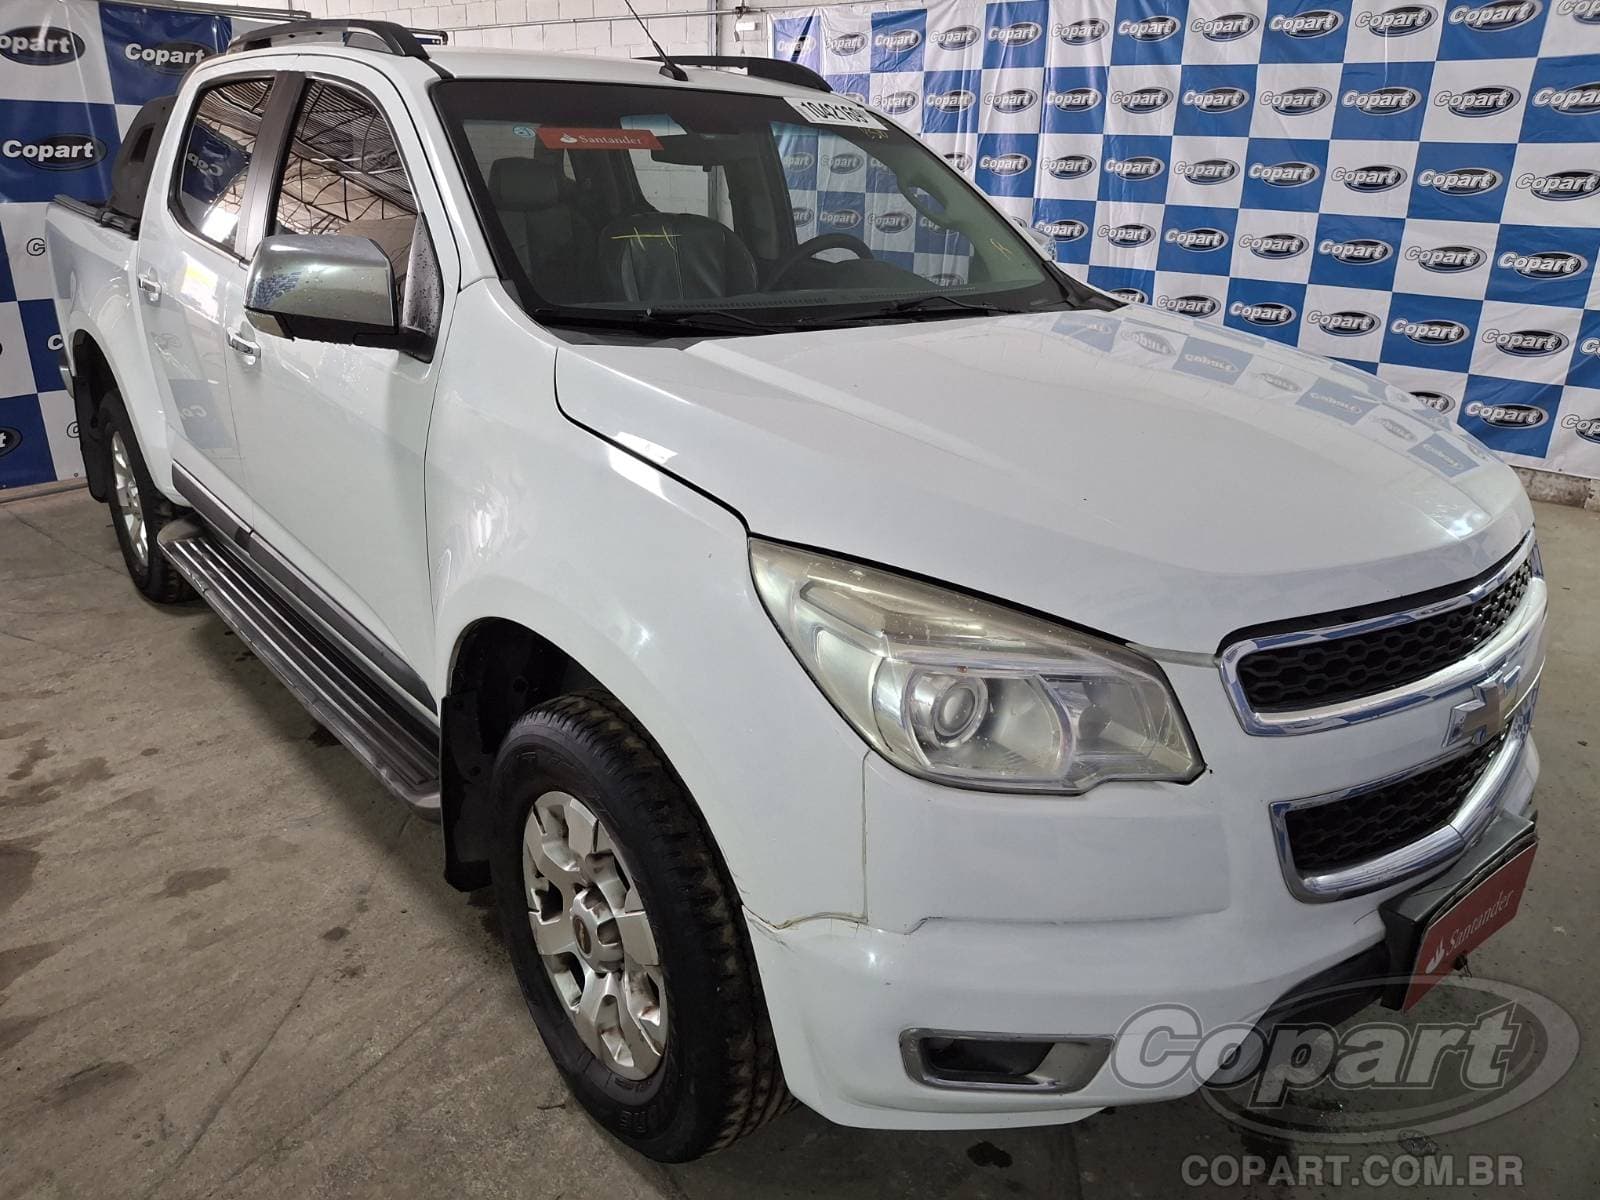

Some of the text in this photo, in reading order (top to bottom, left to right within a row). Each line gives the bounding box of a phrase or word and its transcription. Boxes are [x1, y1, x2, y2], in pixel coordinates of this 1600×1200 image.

[1450, 3, 1536, 30] Copart
[1557, 0, 1600, 19] Cop
[1053, 21, 1102, 40] Copart
[1119, 19, 1171, 39] Copart
[1192, 16, 1250, 37] Copart
[1271, 14, 1333, 34] Copart
[1356, 11, 1428, 32] Copart
[874, 31, 916, 48] Copart
[929, 26, 977, 46] Copart
[988, 24, 1038, 44] Copart
[0, 34, 71, 54] opart
[124, 43, 206, 66] Copart
[873, 93, 915, 109] Copart
[926, 92, 971, 109] Copart
[984, 91, 1032, 108] Copart
[1048, 91, 1095, 107] Copart
[1112, 91, 1166, 107] Copart
[1184, 91, 1241, 107] Copart
[1260, 92, 1323, 108] Copart
[1343, 91, 1413, 109] Copart
[1435, 91, 1510, 109] Copart
[1532, 87, 1600, 111] Copa
[2, 138, 95, 160] Copart
[579, 135, 642, 145] Santander
[979, 155, 1027, 173] Copart
[1040, 155, 1090, 174] Copart
[1106, 158, 1159, 176] Copart
[1174, 162, 1231, 179] Copart
[1249, 163, 1310, 182] Copart
[1332, 168, 1398, 186] Copart
[1419, 170, 1492, 189] Copart
[1517, 174, 1597, 194] Copart
[868, 214, 906, 228] Copart
[1098, 225, 1147, 243] Copart
[1166, 229, 1222, 247] Copart
[1240, 235, 1299, 253] Copart
[1320, 240, 1386, 261] Copart
[1405, 247, 1476, 268] Copart
[1499, 253, 1575, 275] Copart
[1158, 296, 1213, 313] Copart
[1230, 304, 1287, 322] Copart
[1308, 311, 1372, 332] Copart
[1391, 320, 1463, 342] Copart
[1483, 329, 1559, 351] Copart
[1466, 403, 1540, 425] Copart
[1561, 414, 1600, 437] Cop
[1450, 889, 1514, 951] Santander
